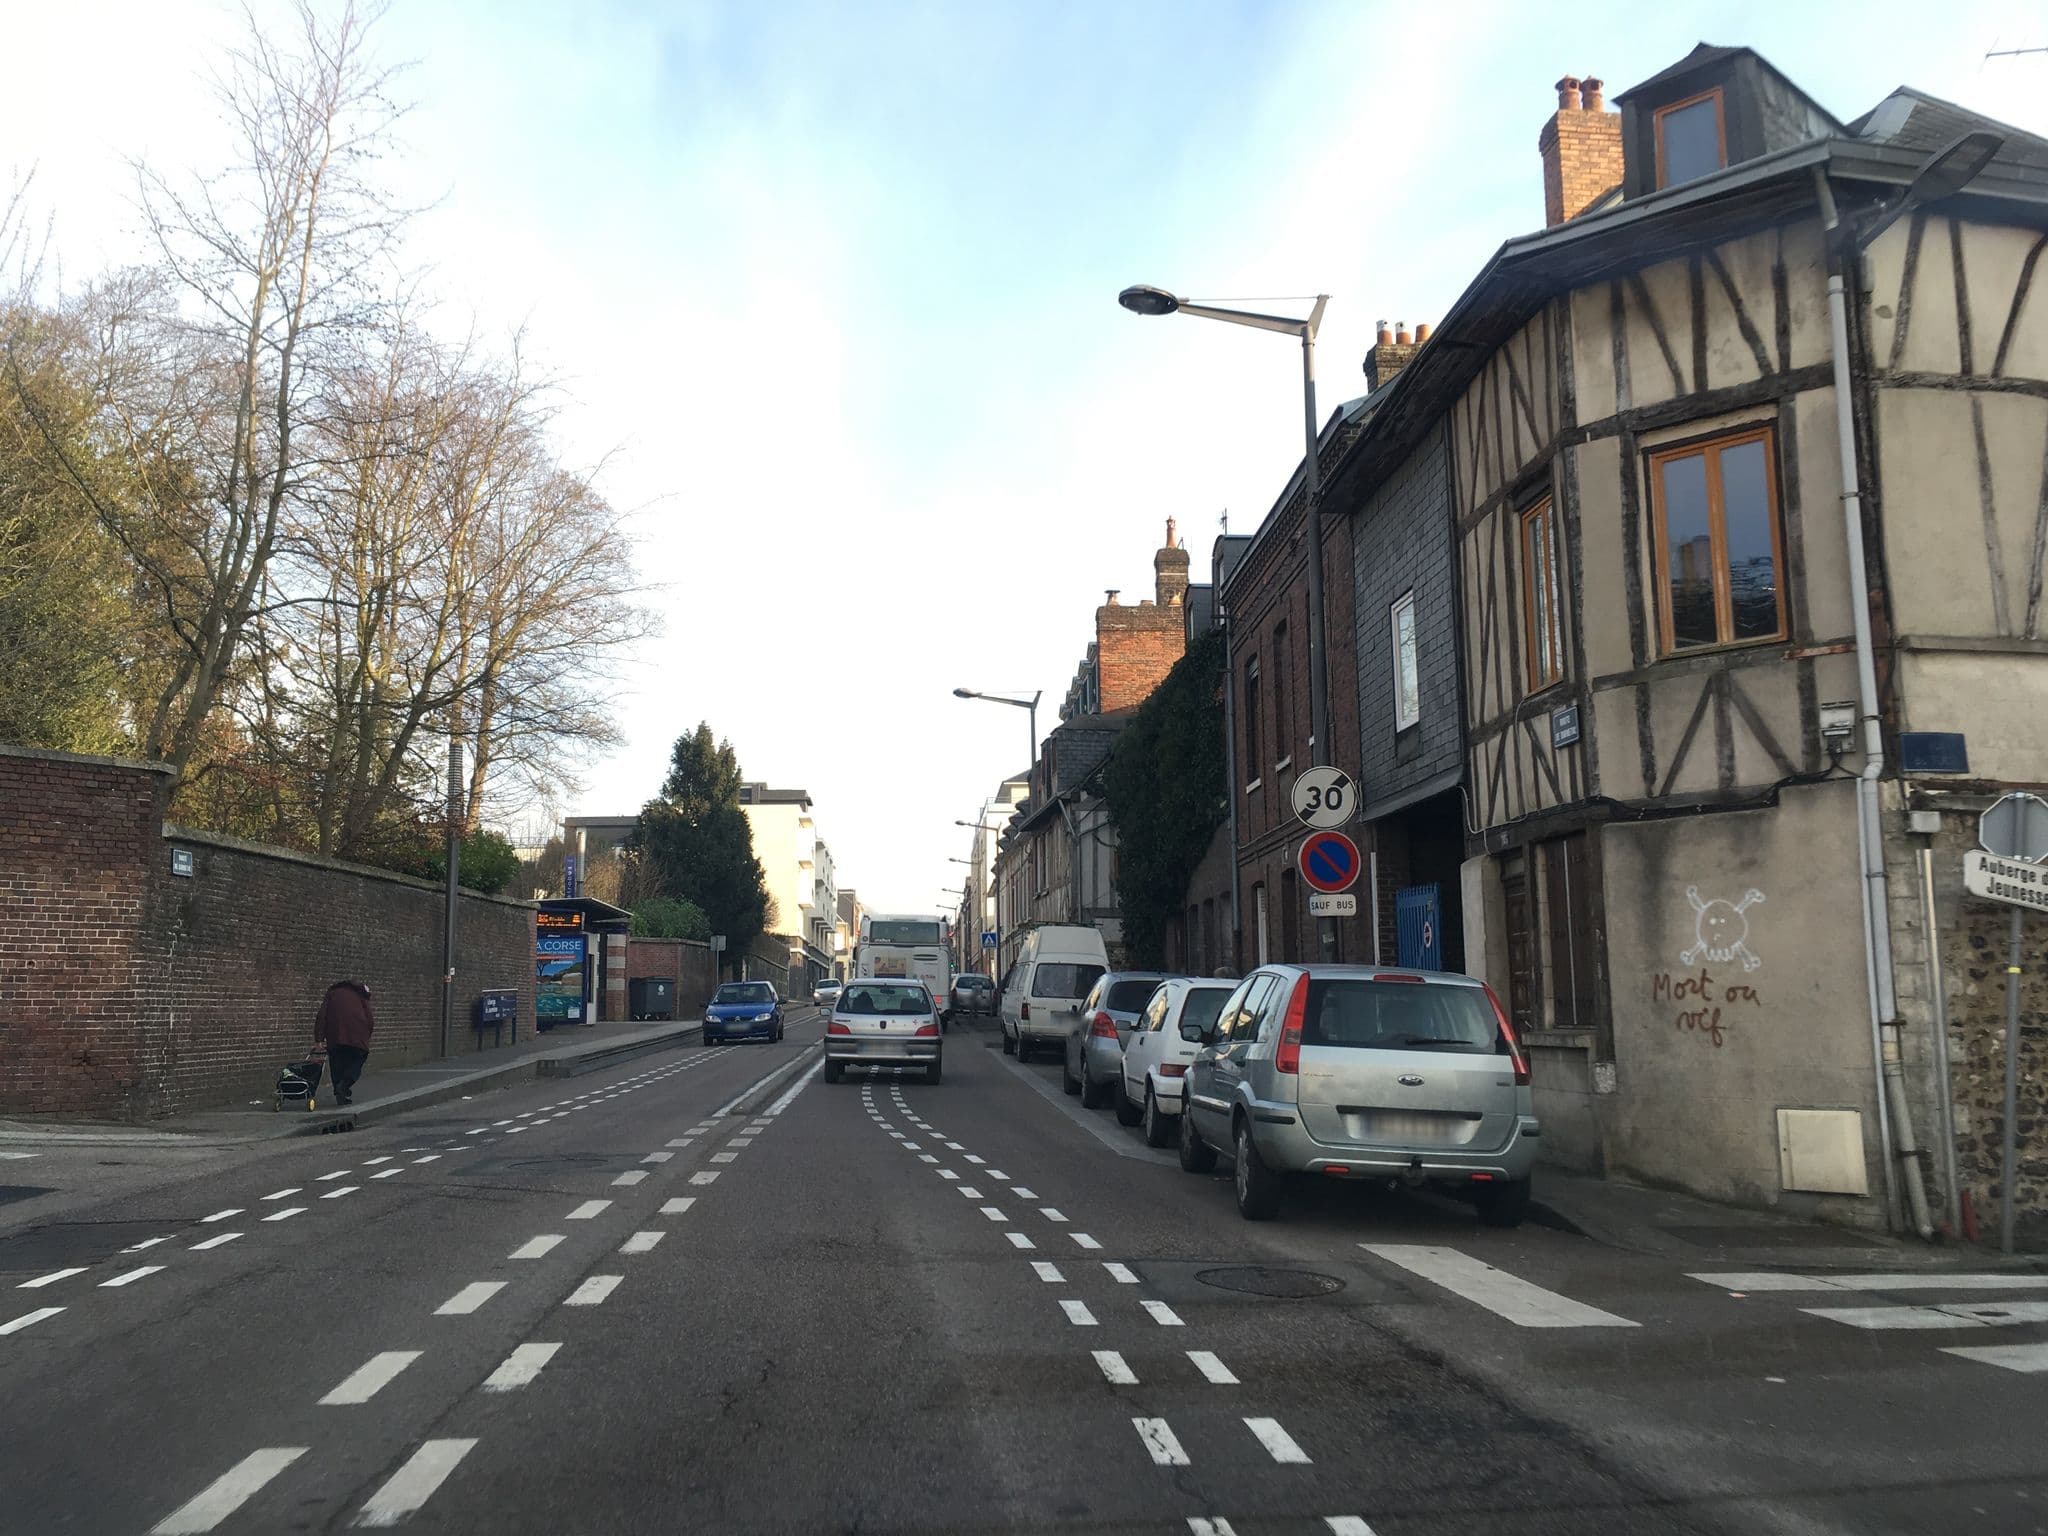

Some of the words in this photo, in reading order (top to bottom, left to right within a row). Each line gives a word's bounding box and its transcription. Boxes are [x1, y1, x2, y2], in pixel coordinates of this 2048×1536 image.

[1306, 786, 1342, 811] 30
[1979, 857, 2036, 883] Auberge
[1311, 901, 1331, 910] SAUF
[1337, 900, 1354, 909] BUS
[544, 940, 582, 951] CORSE
[1653, 968, 1713, 1002] Mort
[1676, 1007, 1728, 1048] vif
